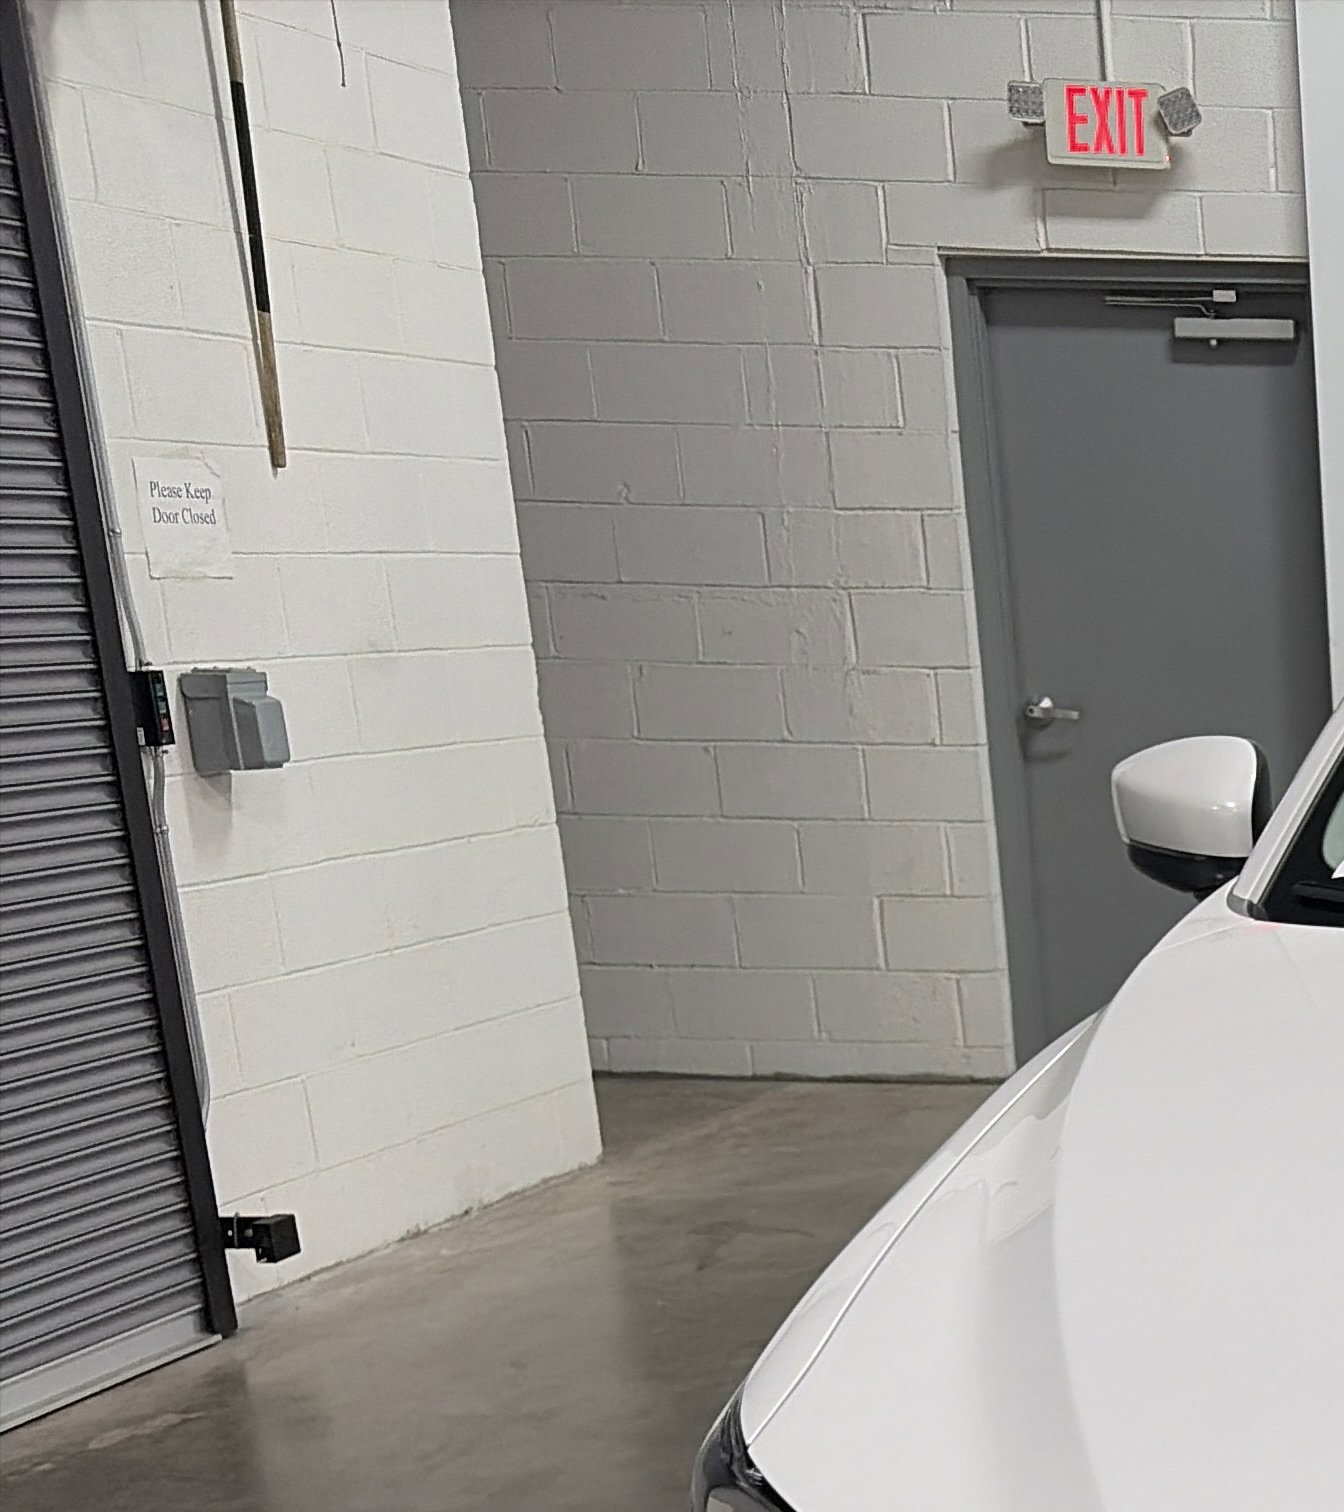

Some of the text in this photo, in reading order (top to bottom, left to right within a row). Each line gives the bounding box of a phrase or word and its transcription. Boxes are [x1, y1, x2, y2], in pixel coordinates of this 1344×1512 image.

[1064, 85, 1148, 156] EXIT
[149, 481, 211, 504] Please Keep
[152, 506, 216, 525] Door Closed
